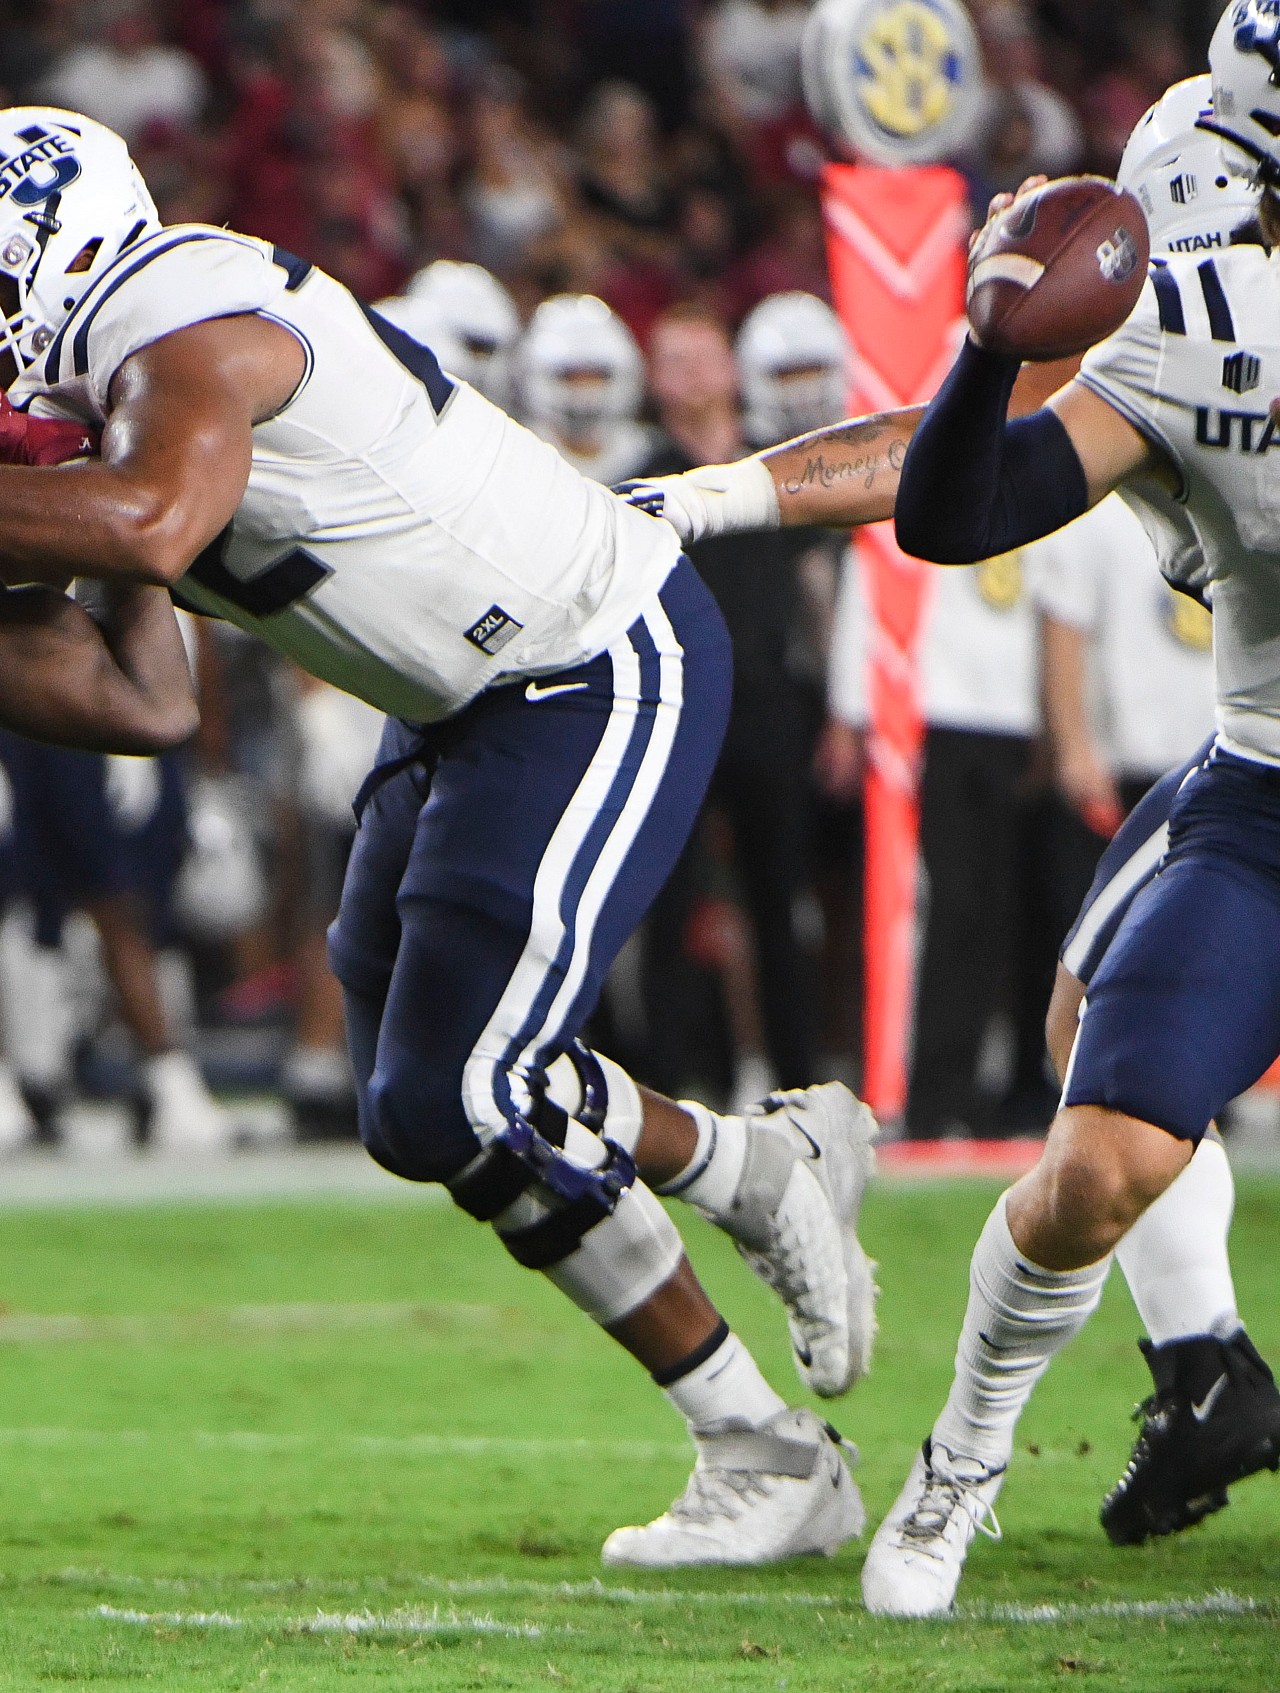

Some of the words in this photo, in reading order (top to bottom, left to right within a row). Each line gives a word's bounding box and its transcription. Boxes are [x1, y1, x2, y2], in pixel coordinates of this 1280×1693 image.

[1168, 231, 1222, 252] UTAH
[784, 454, 880, 494] Money
[473, 614, 504, 641] 2XL
